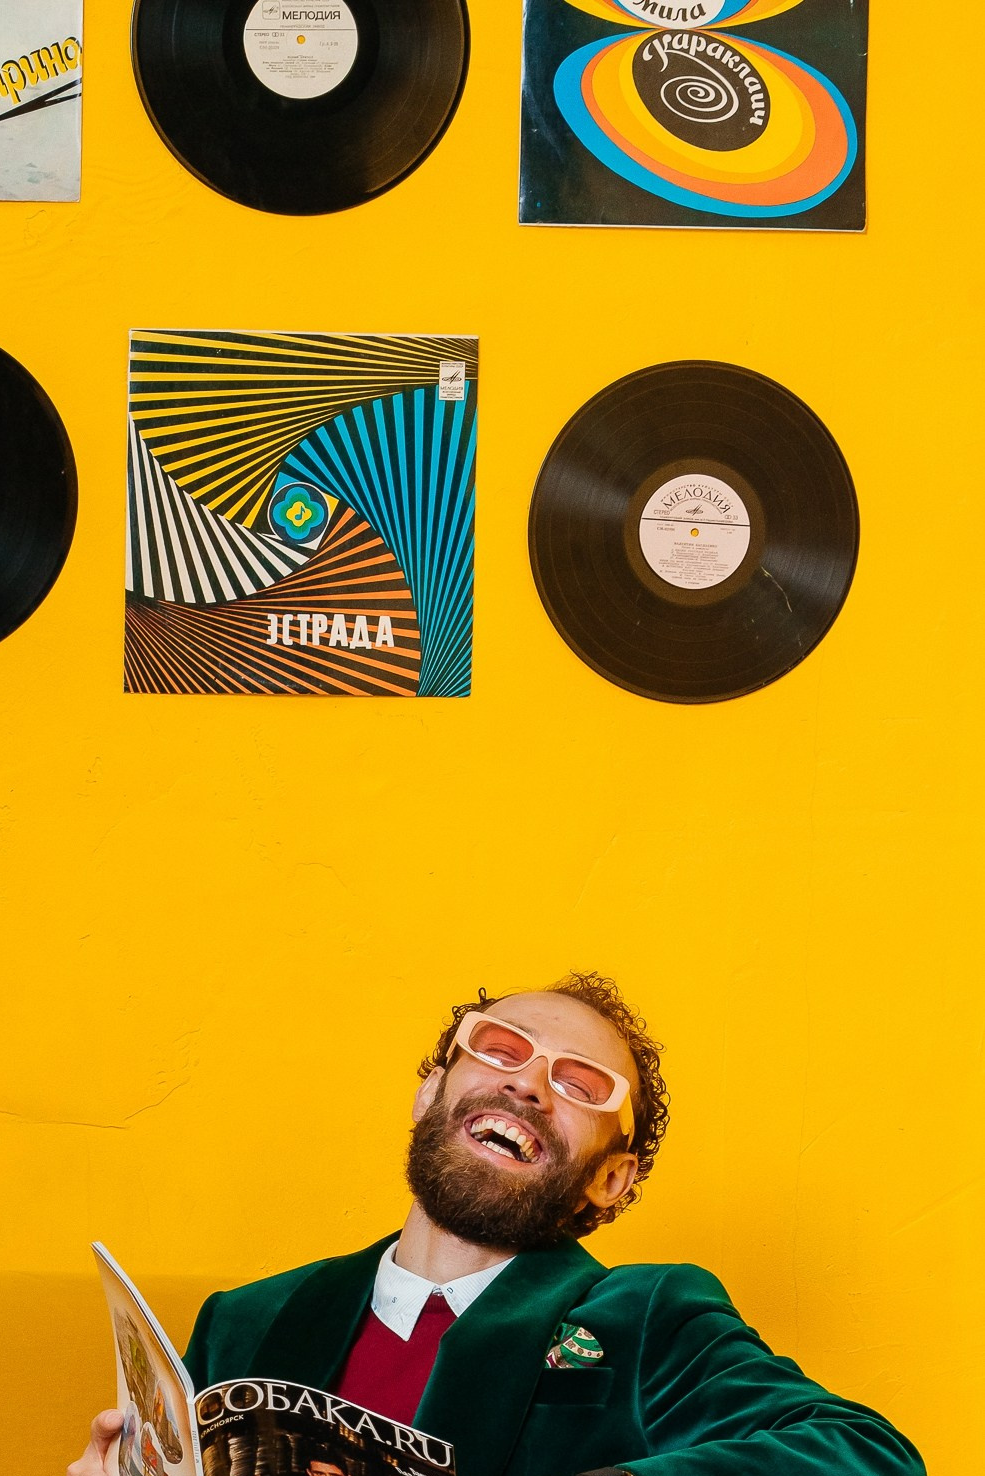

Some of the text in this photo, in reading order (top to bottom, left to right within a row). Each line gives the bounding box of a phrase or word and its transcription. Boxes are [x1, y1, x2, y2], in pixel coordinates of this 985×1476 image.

[282, 10, 341, 21] МЕЛОДИЯ
[663, 487, 731, 513] МЕЛОДИЯ
[266, 613, 395, 650] ЭСТРАДА
[197, 1382, 452, 1467] СОБАКА.RU
[200, 1413, 245, 1439] КРАСНОЯРСК
